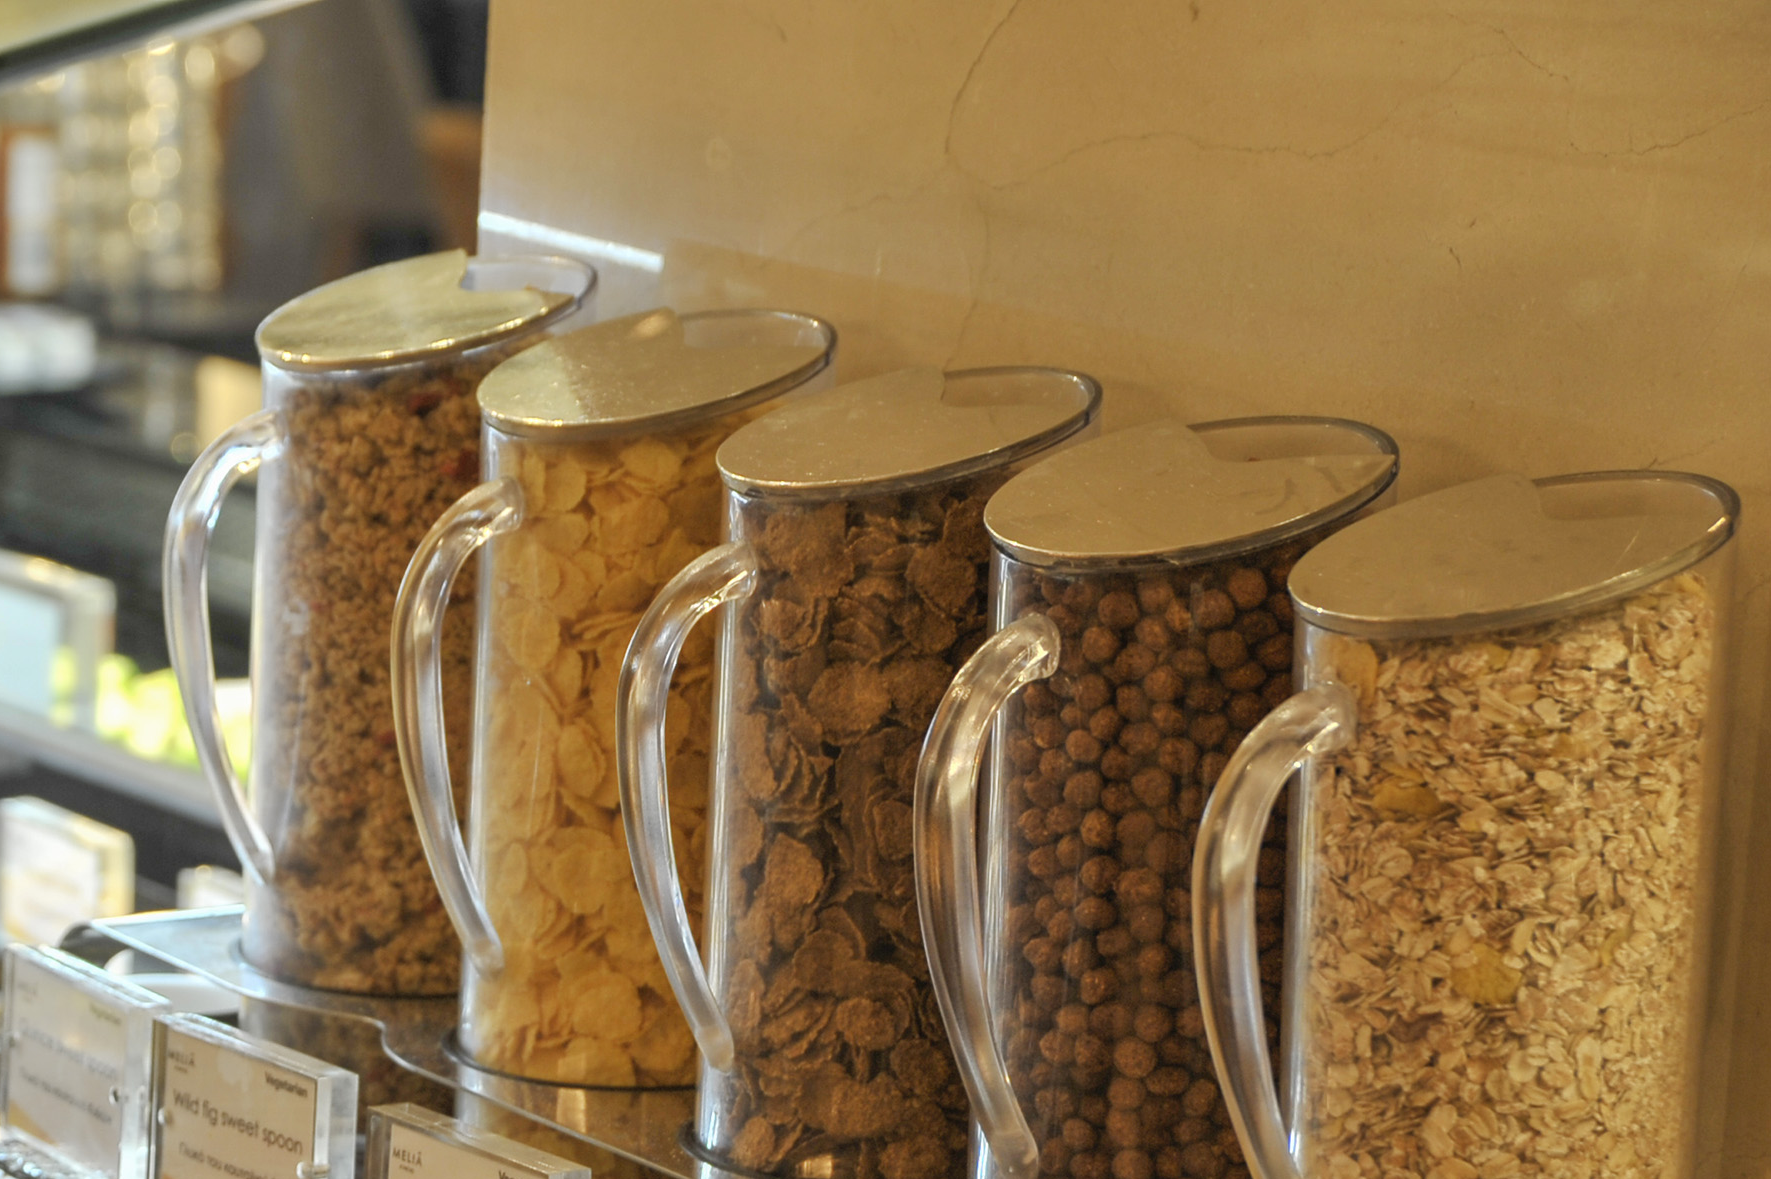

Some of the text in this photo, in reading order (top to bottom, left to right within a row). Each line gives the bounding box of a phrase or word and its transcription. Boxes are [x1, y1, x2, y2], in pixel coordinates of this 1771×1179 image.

[265, 1071, 308, 1098] Vegetarian
[173, 1090, 303, 1155] Wild fig sweet spoon
